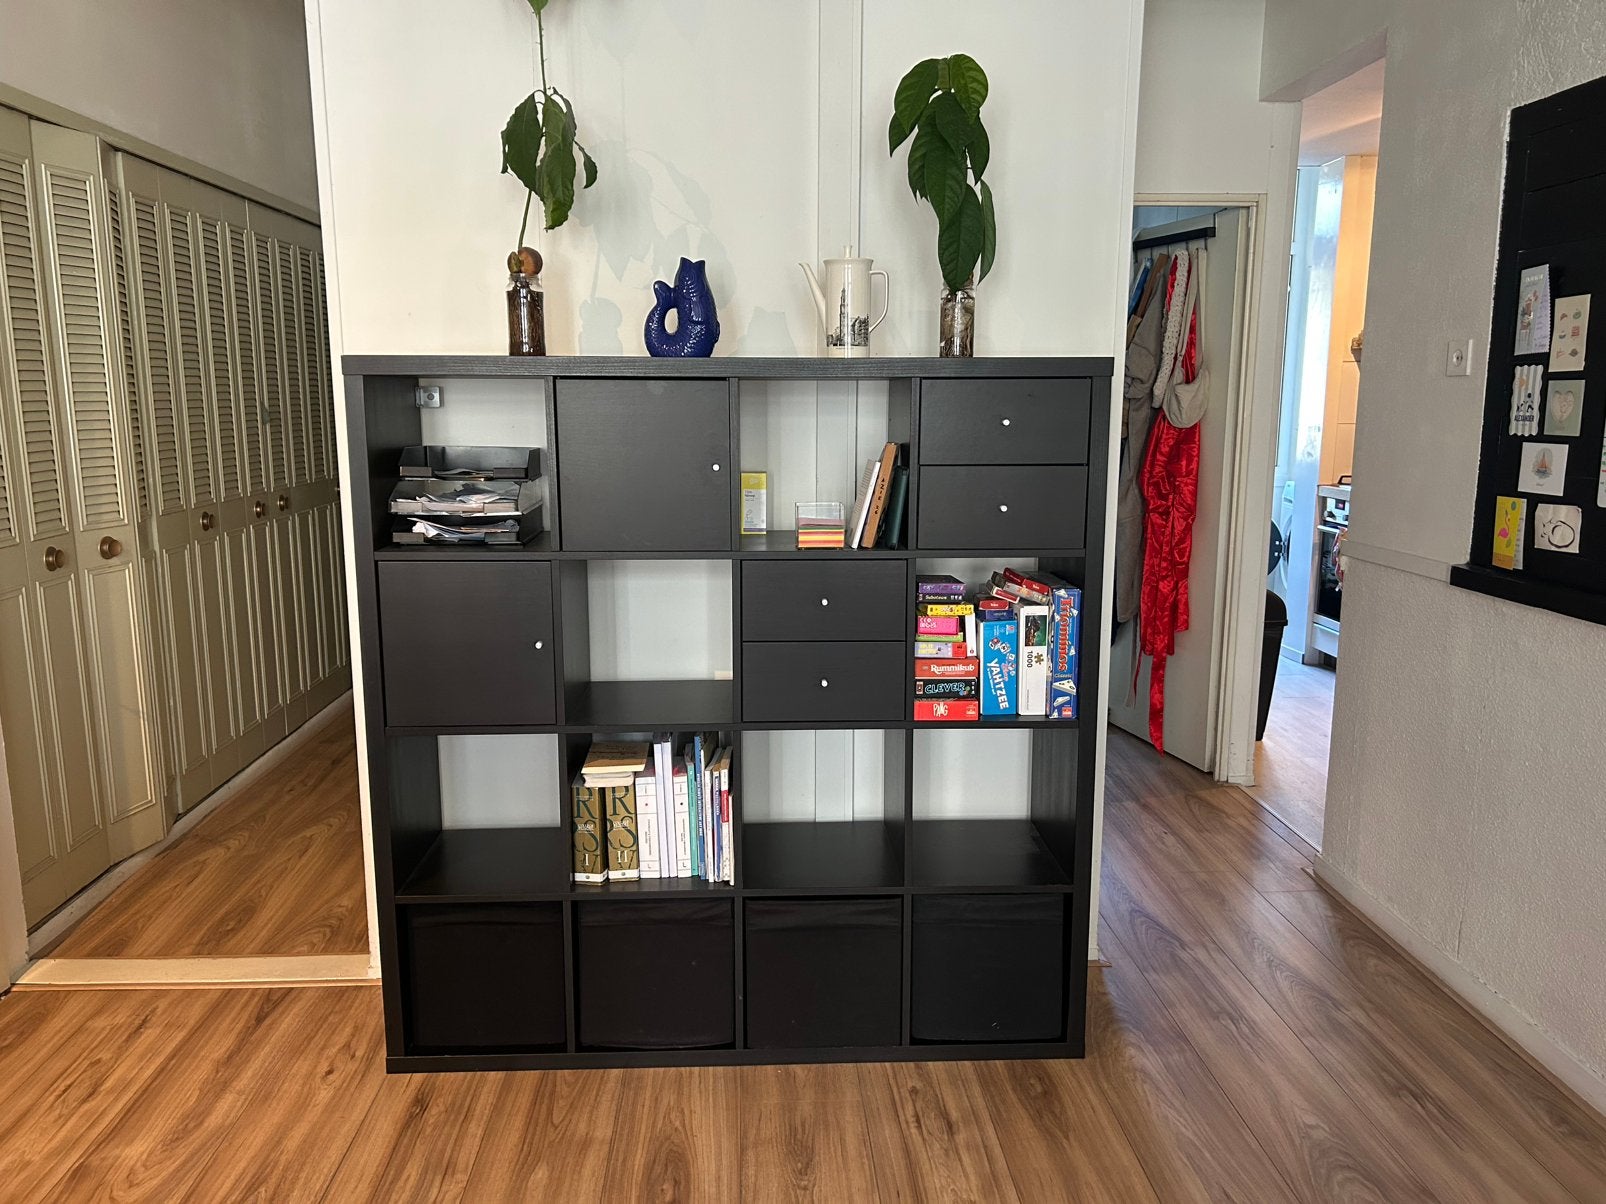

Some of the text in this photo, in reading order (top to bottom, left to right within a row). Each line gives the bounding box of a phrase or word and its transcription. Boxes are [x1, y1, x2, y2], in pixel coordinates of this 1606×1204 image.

[930, 664, 975, 675] Rummikub
[925, 682, 965, 694] CLEVER
[987, 658, 1010, 709] YAHTZEE
